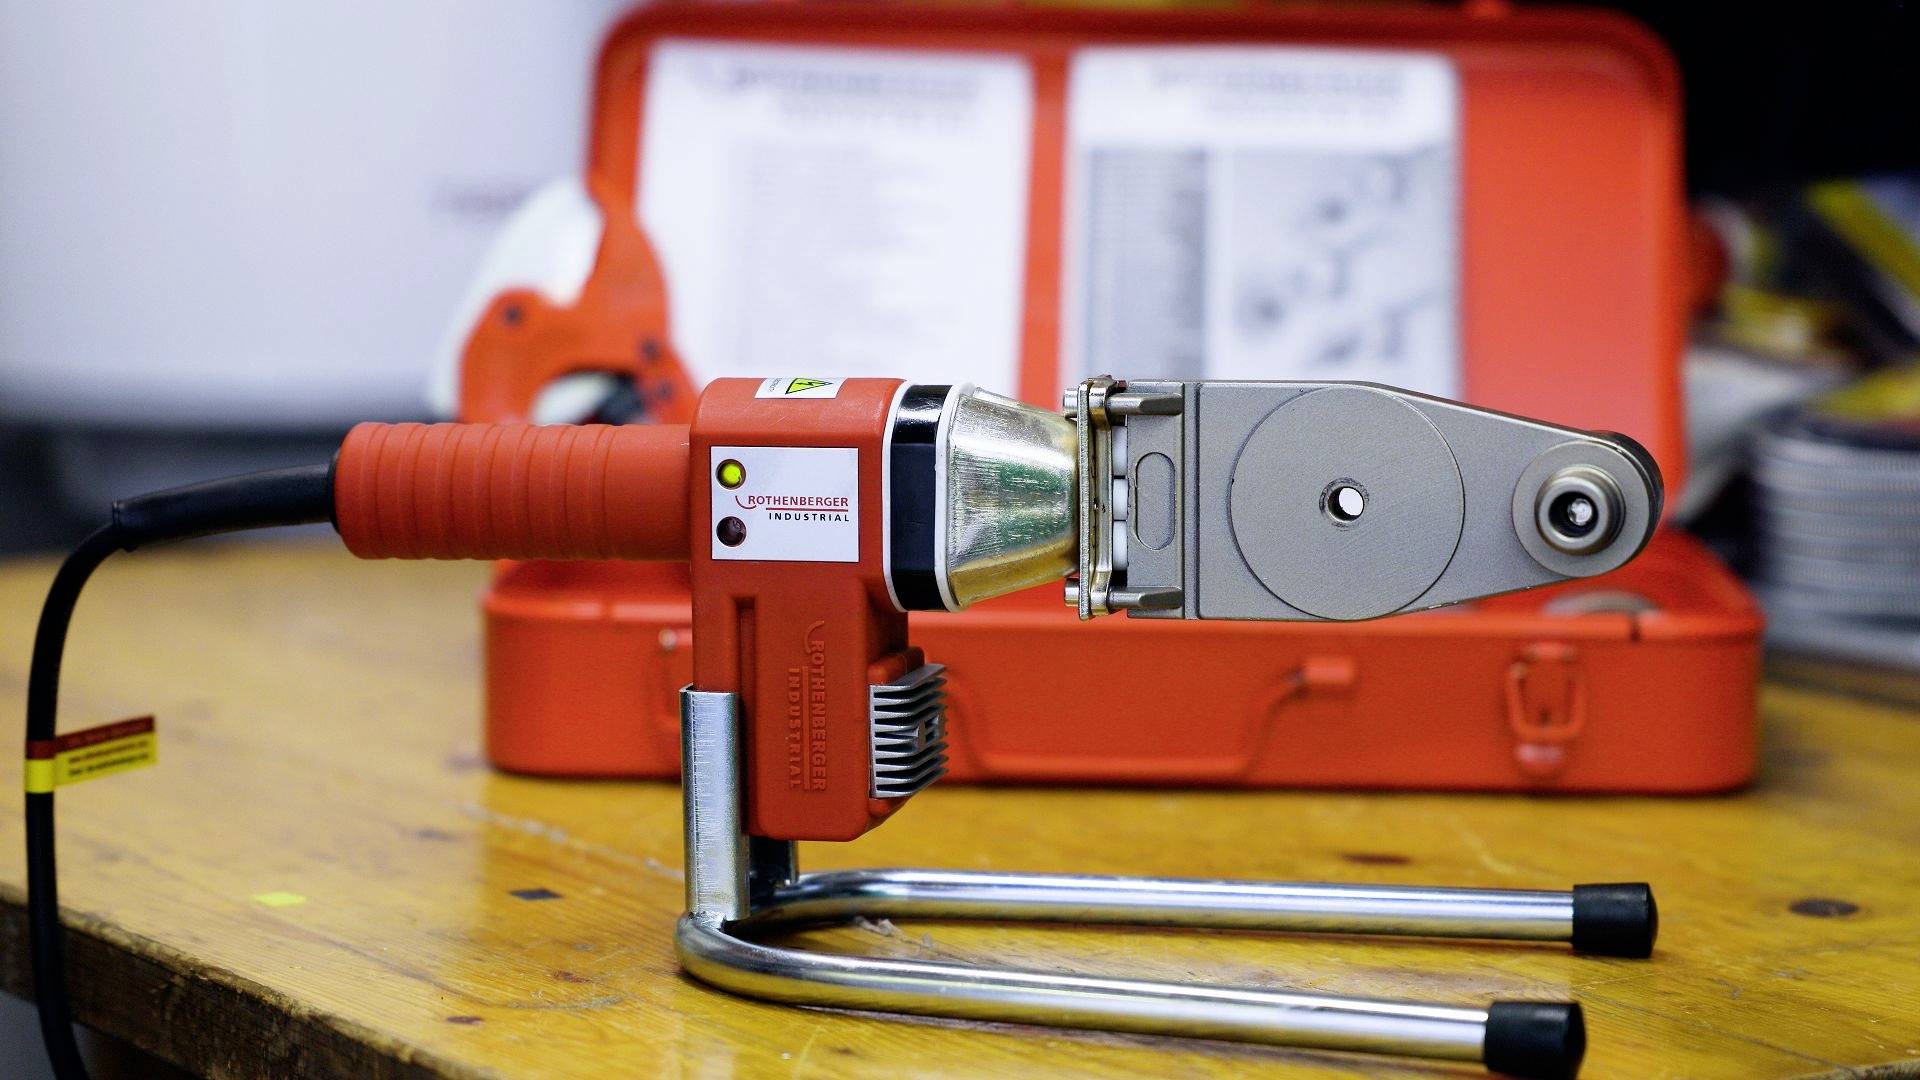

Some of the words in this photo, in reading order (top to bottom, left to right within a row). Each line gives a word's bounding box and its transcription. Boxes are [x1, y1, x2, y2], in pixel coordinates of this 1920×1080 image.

[748, 495, 849, 507] ROTHENBERGER
[769, 512, 850, 522] INDUSTRIAL
[788, 667, 801, 788] INDUSTRIAL
[811, 640, 826, 791] ROTHENBERGER
